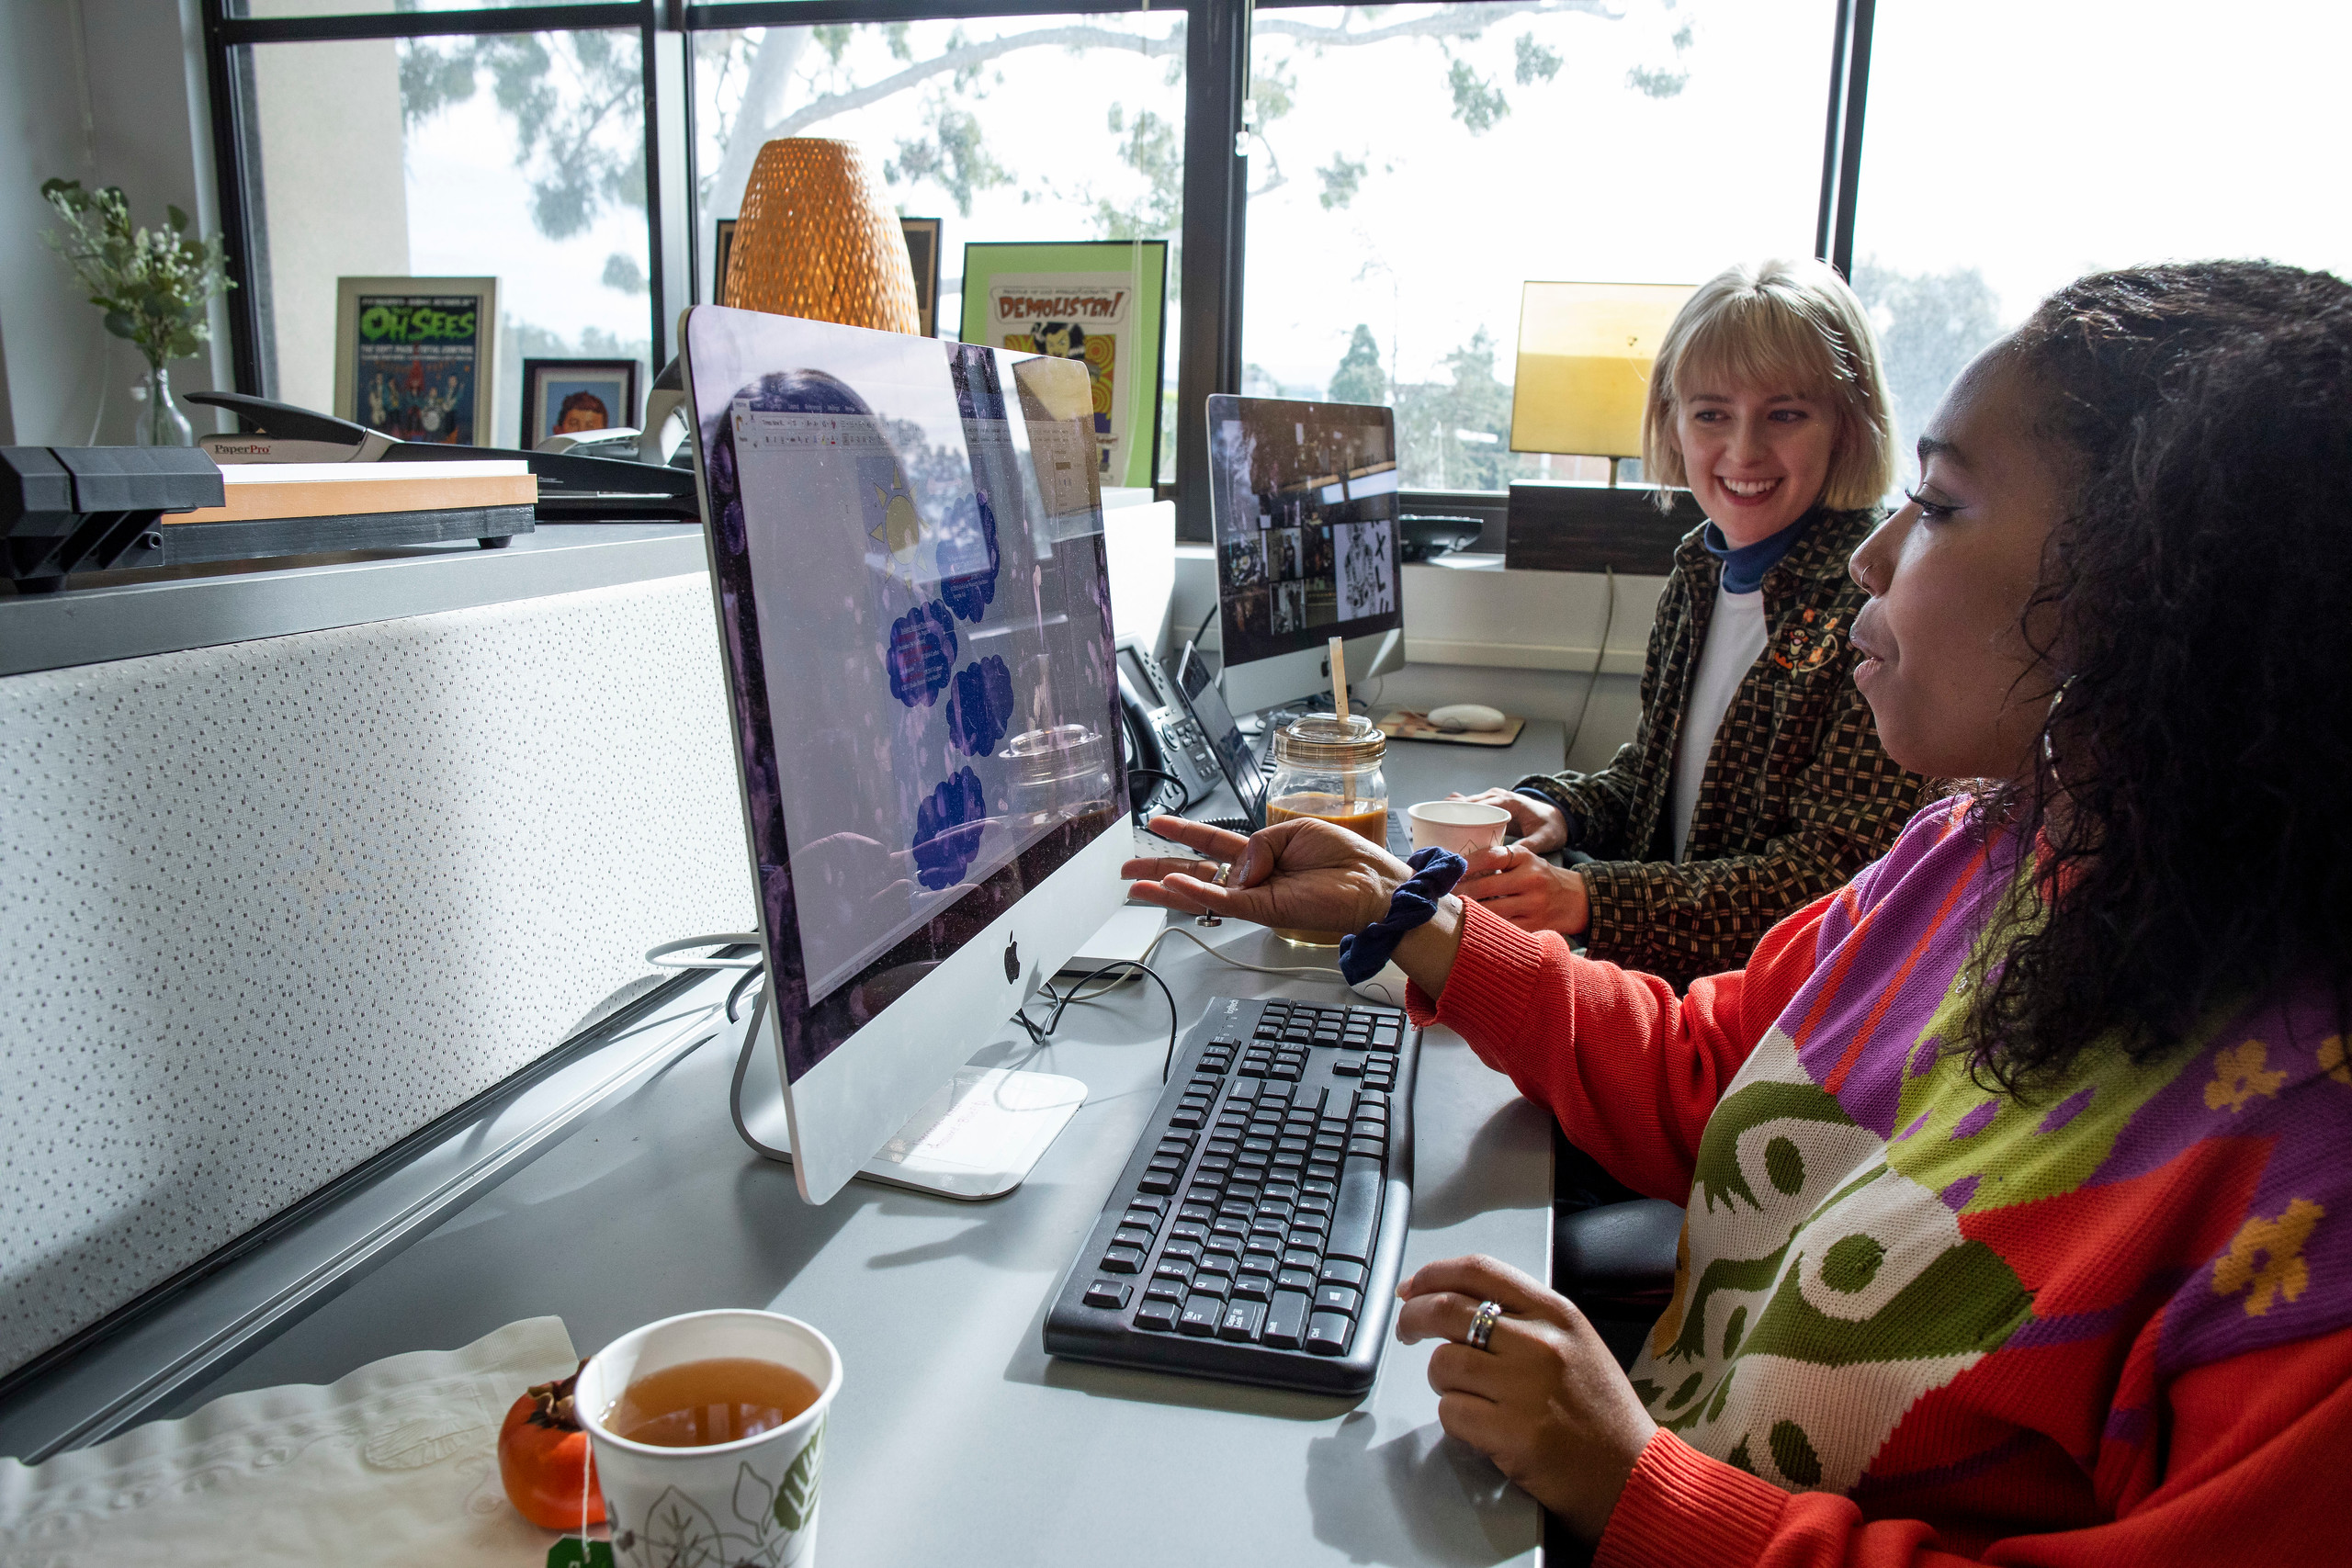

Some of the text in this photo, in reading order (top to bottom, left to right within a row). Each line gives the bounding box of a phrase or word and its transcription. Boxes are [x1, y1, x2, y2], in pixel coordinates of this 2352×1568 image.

[999, 292, 1125, 319] DEMOLISTEN!
[361, 306, 475, 342] OH SEES
[215, 445, 269, 455] PaperPro
